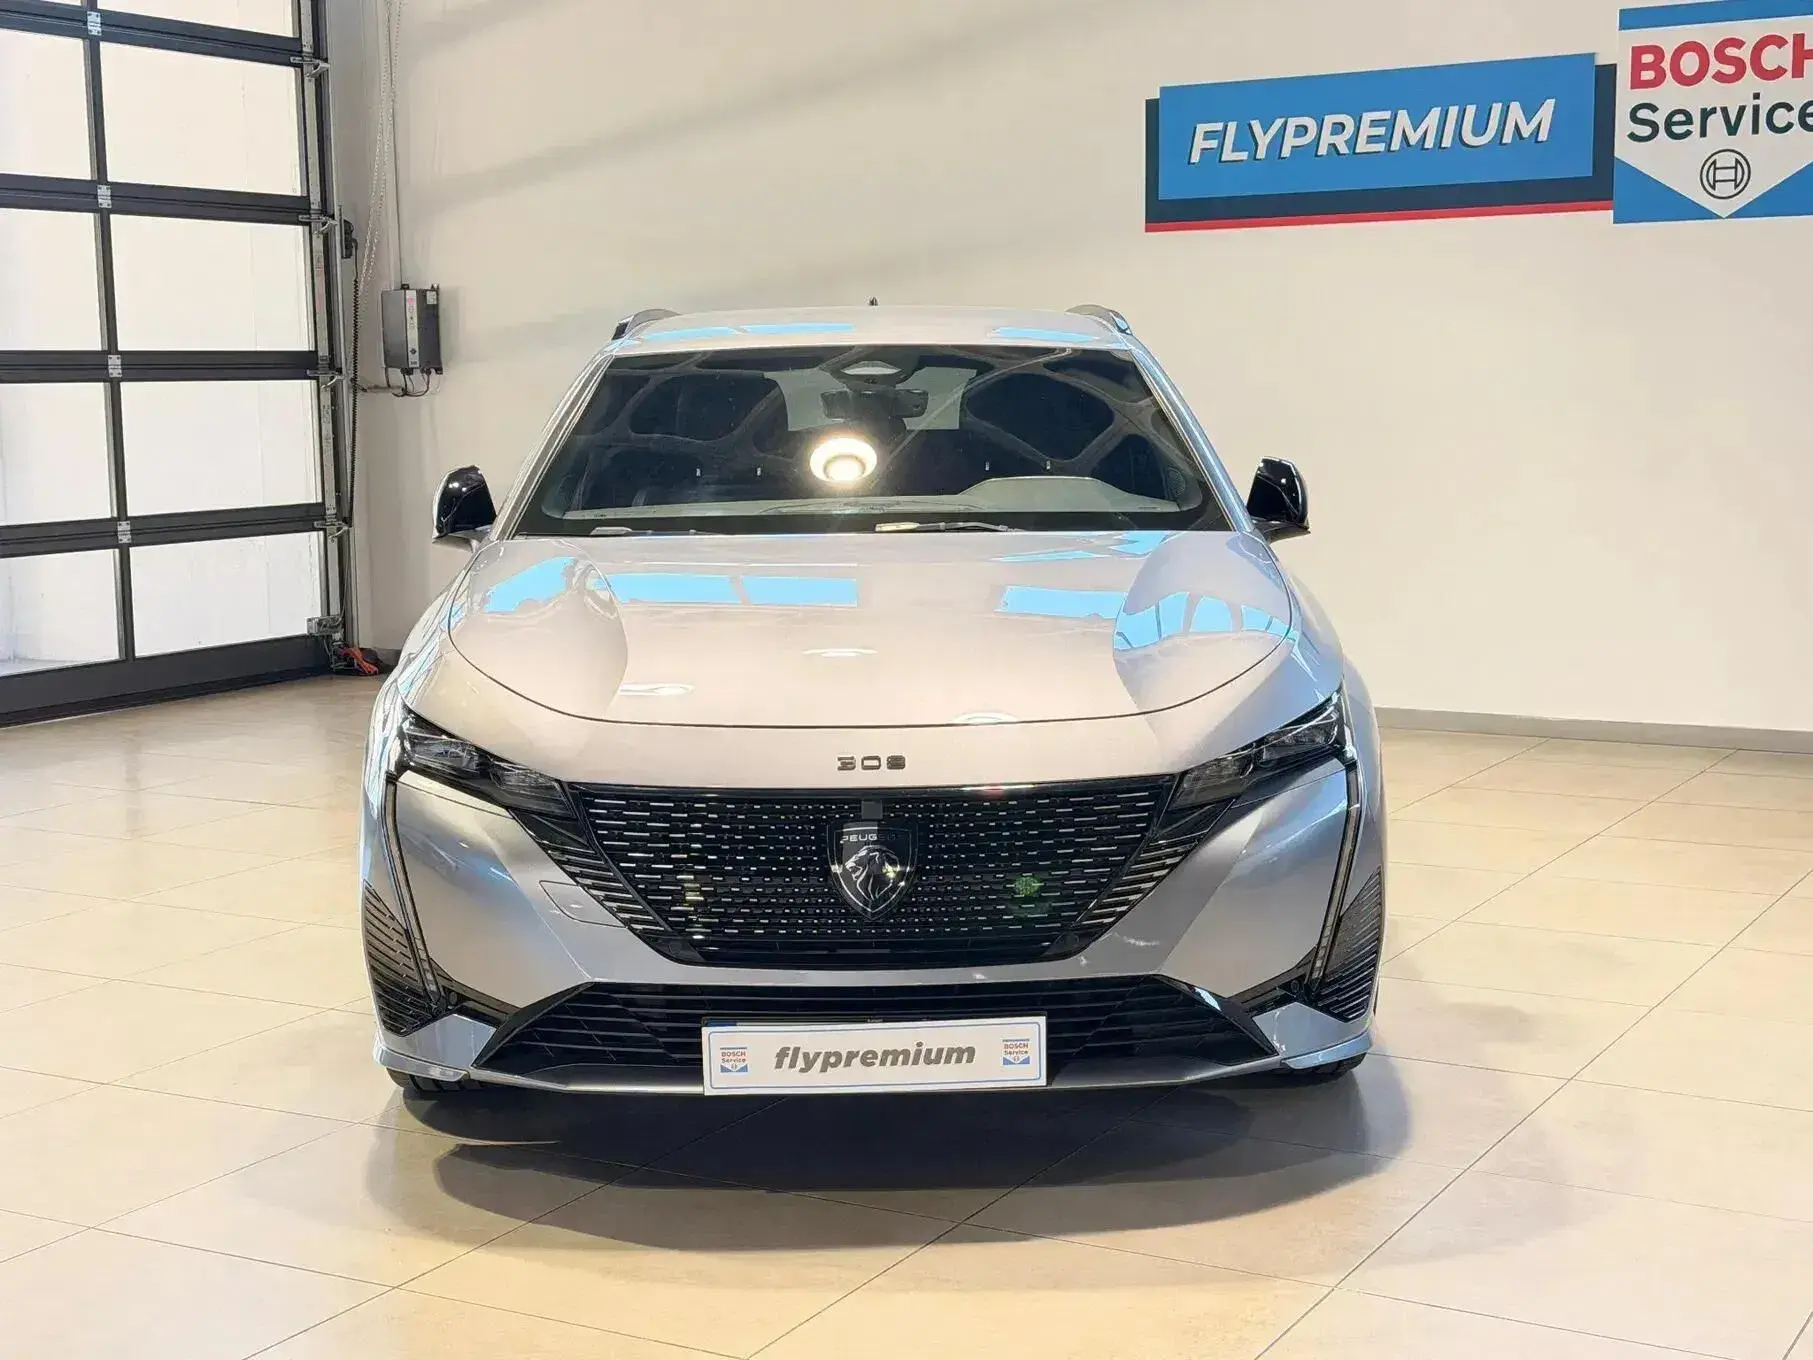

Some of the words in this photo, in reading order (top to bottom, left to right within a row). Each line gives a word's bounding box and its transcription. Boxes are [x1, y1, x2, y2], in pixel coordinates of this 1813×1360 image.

[1187, 98, 1556, 165] FLYPREMIUM
[837, 755, 906, 770] 308
[774, 1042, 976, 1073] flypremium
